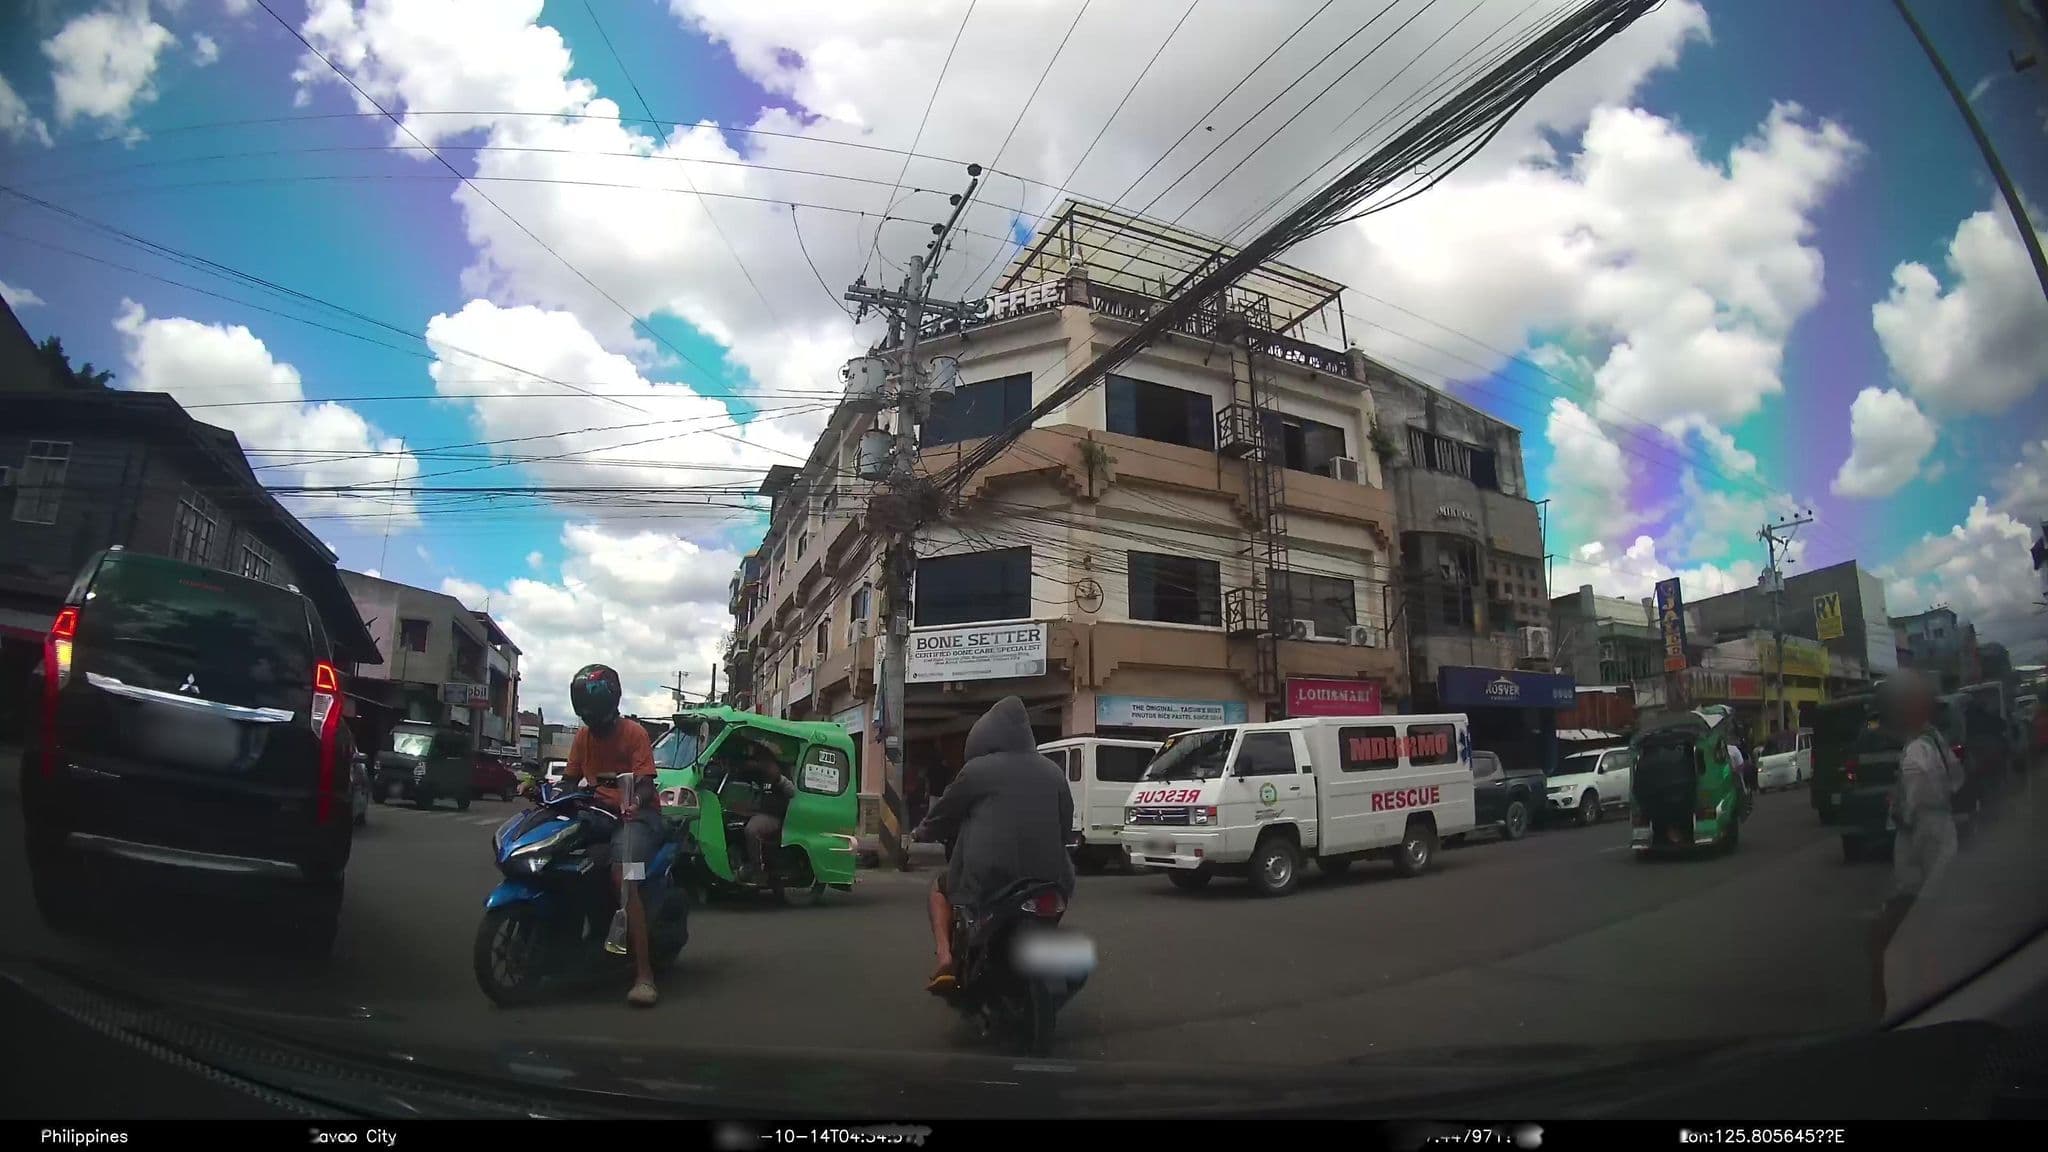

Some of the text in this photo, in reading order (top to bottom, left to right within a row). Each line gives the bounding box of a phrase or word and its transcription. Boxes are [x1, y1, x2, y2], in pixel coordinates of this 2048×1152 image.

[916, 629, 1041, 650] BONE SETTER
[915, 651, 951, 659] CERTIFIED
[1372, 785, 1440, 812] RESCUE
